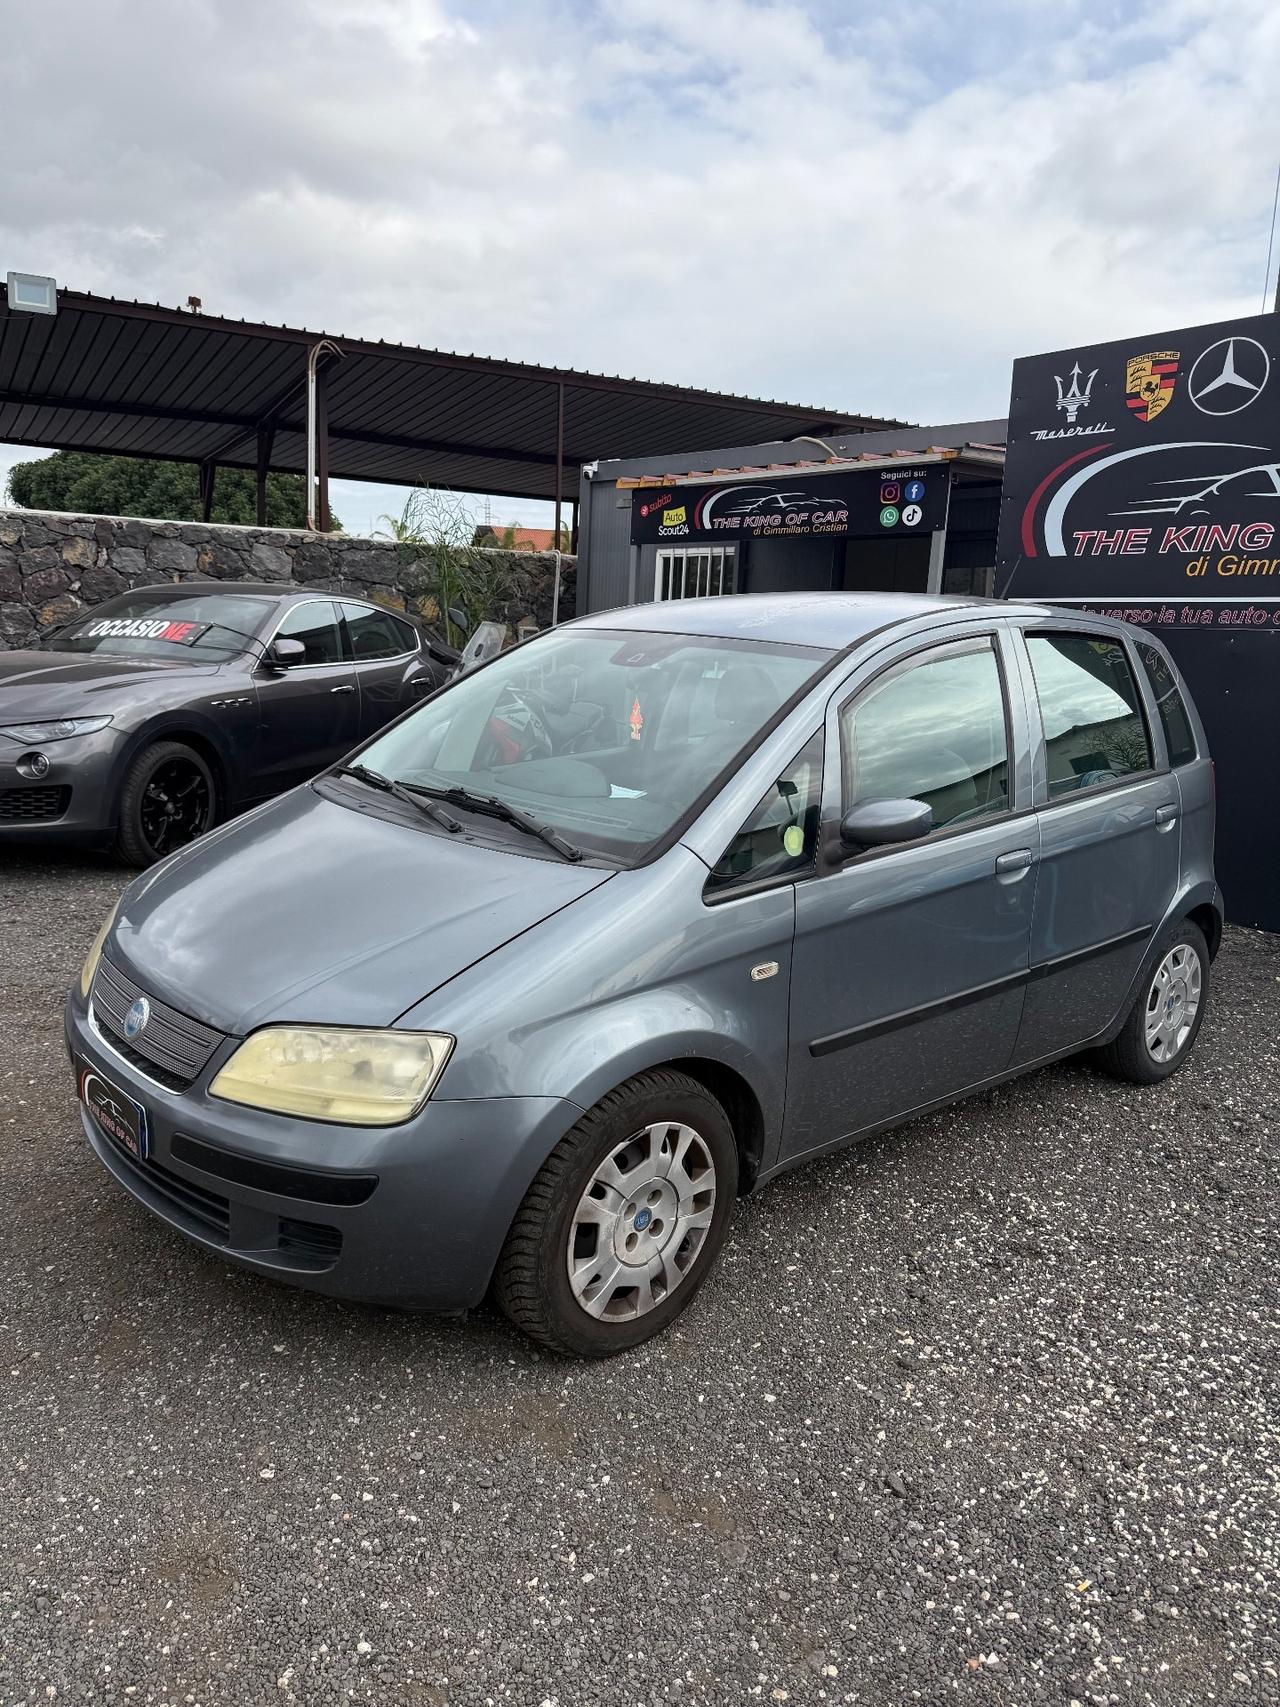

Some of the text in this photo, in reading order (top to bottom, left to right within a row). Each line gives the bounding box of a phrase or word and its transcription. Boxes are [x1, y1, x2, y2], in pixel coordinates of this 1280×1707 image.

[1128, 351, 1179, 367] PORSCHE
[1030, 422, 1116, 441] Maserati
[880, 469, 927, 480] Seguici su:
[649, 494, 672, 512] subito
[665, 512, 684, 522] Auto
[712, 509, 849, 529] THE KING OF CAR
[658, 524, 690, 536] Scout24
[753, 522, 848, 536] di Gimmillaro Cristian
[1073, 523, 1275, 557] THE KING
[1186, 555, 1209, 577] di
[1157, 604, 1176, 624] la
[1180, 605, 1214, 625] tua
[1218, 605, 1268, 625] auto
[88, 619, 197, 641] OCCASIONE
